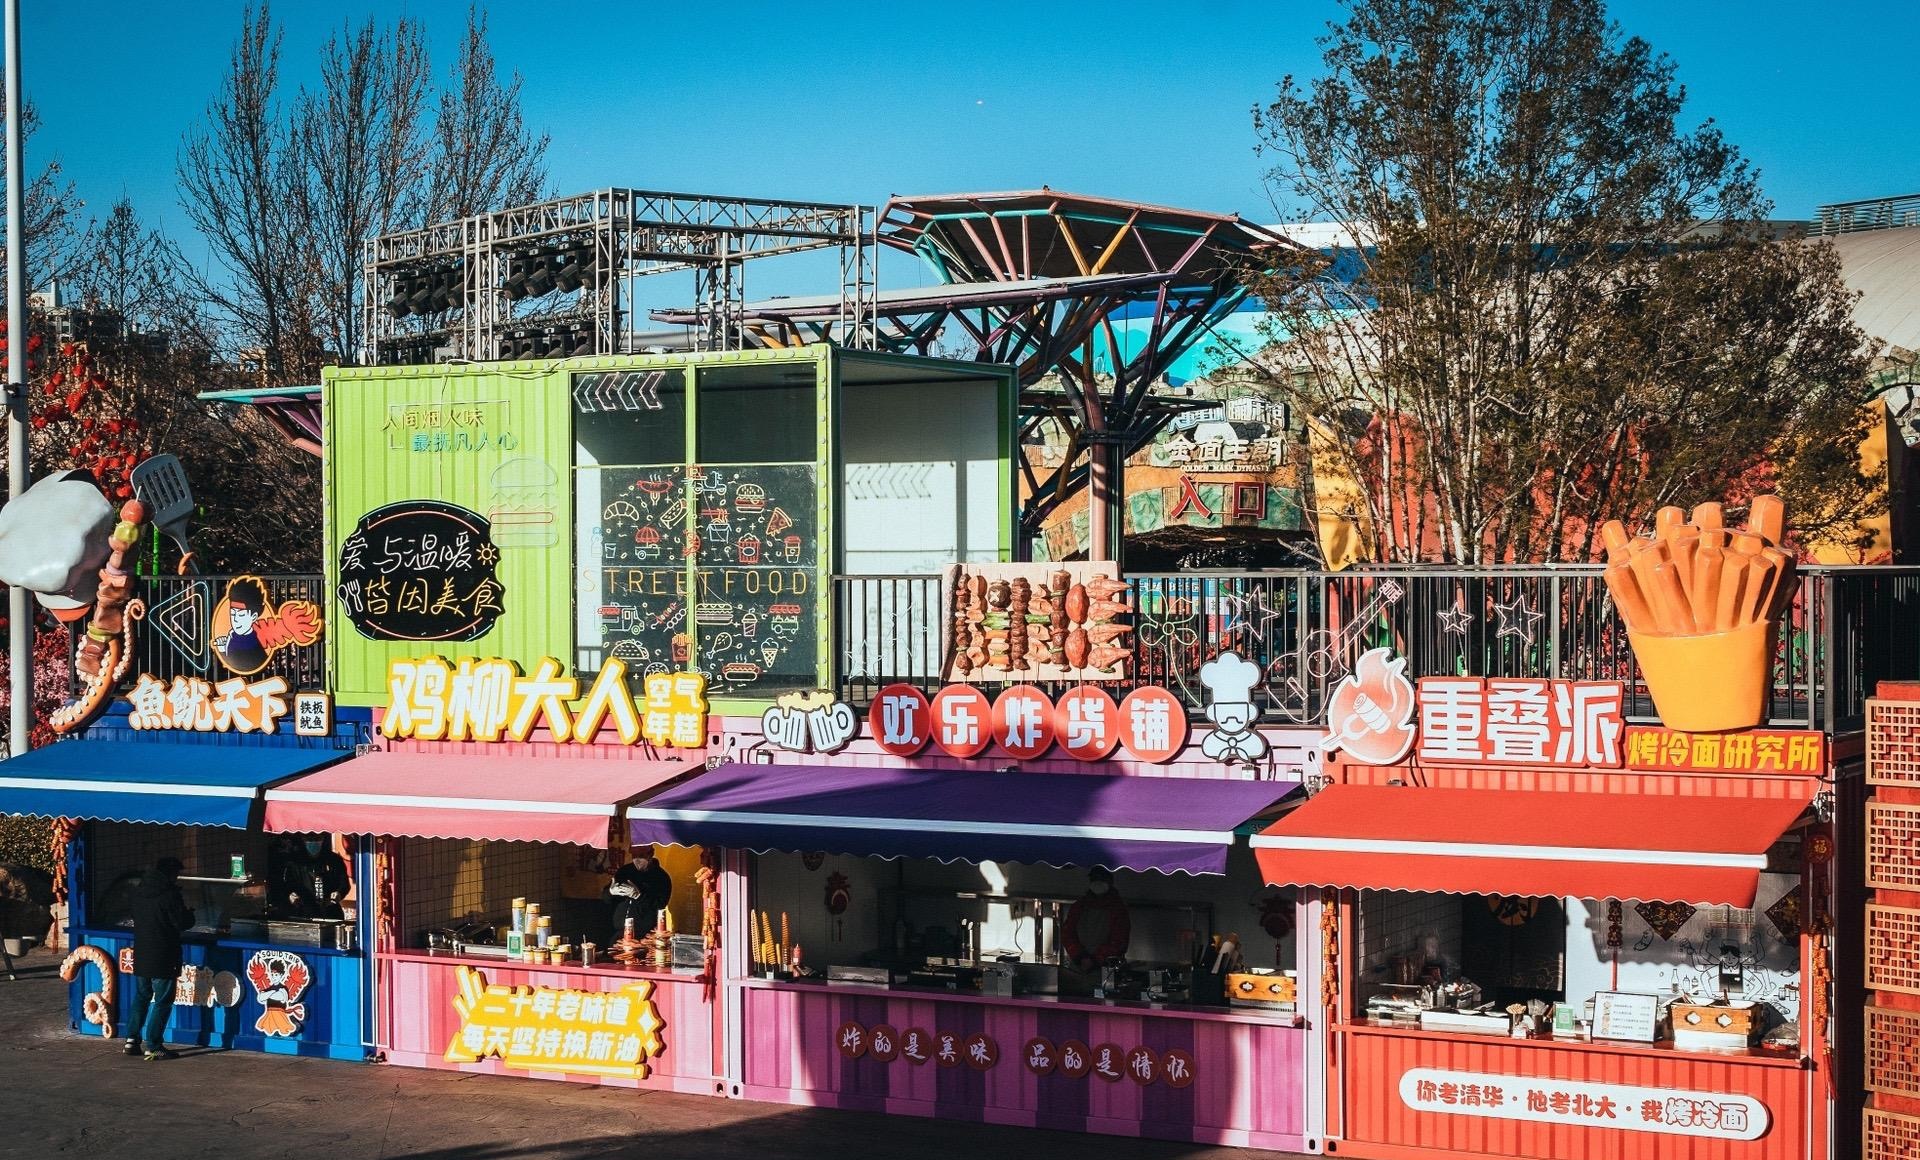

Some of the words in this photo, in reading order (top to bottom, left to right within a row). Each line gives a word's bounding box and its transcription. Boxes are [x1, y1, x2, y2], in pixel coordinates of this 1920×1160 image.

[382, 408, 485, 431] 人间烟火味
[411, 432, 519, 453] 最抚凡人心
[1163, 434, 1284, 466] 金面王朝
[1171, 474, 1265, 519] 入口
[339, 528, 473, 574] 爱与温暖
[364, 575, 502, 618] 皆因美食
[582, 569, 714, 595] STREET
[725, 569, 808, 595] FOOD
[299, 700, 325, 714] 铁板
[383, 658, 638, 741] 鸡柳大人
[648, 677, 702, 709] 空气
[299, 715, 325, 730] 鱿鱼
[646, 711, 701, 743] 年糕
[882, 694, 1170, 752] 欢乐炸货铺
[1420, 682, 1620, 764] 重叠派
[1628, 731, 1820, 771] 烤冷面研究所
[261, 951, 284, 959] SQUID
[284, 952, 301, 964] TRIP
[483, 986, 631, 1025] 二十年老味道
[462, 1023, 641, 1062] 每天坚持换新油
[842, 1027, 992, 1070] 炸的是美味
[1029, 1043, 1190, 1082] 品的是情怀
